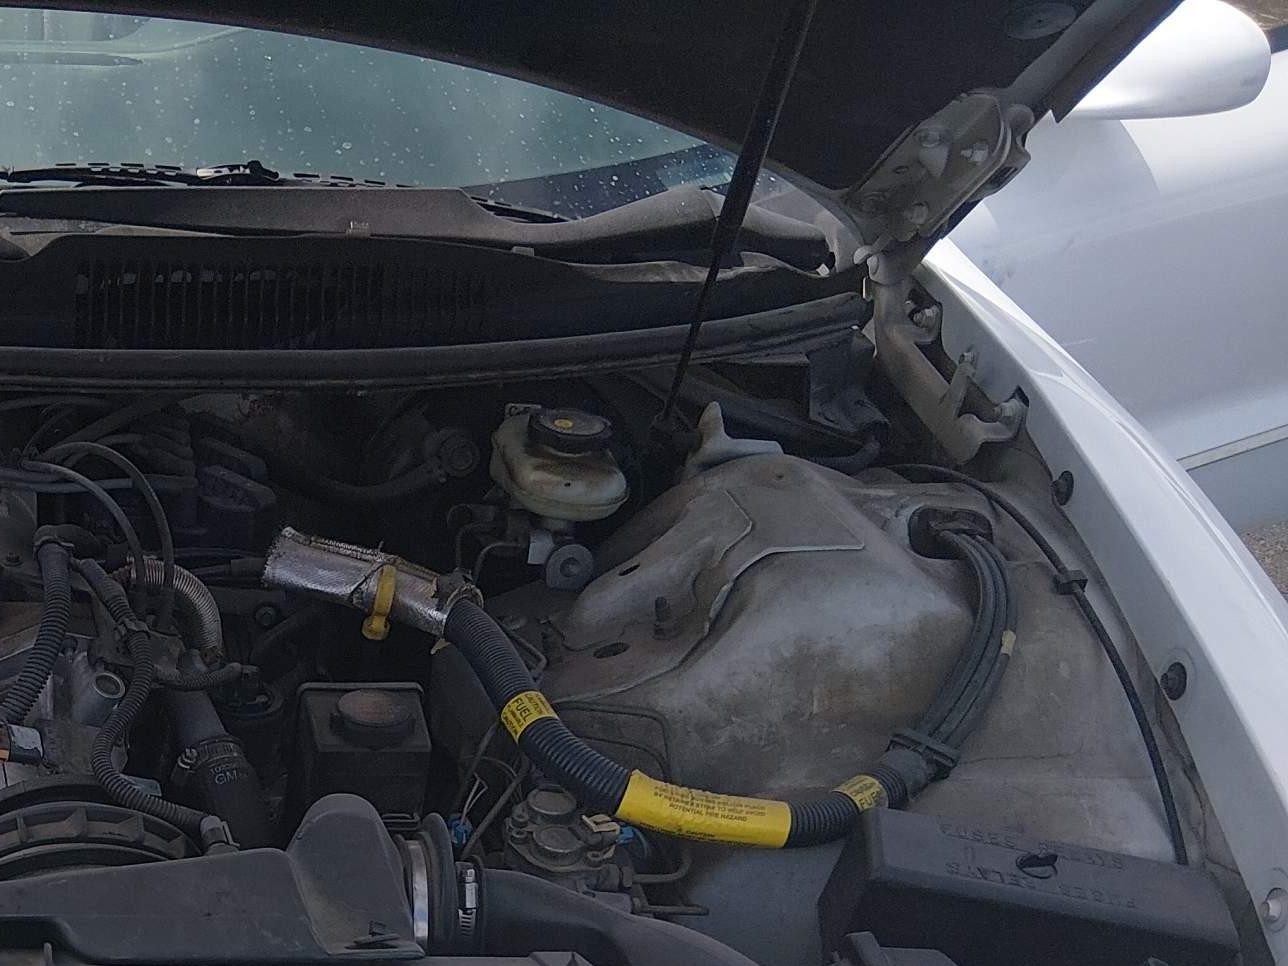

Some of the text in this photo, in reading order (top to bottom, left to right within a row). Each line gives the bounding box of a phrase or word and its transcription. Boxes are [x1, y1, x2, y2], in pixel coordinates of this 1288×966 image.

[512, 697, 533, 722] FUEL
[669, 803, 704, 817] POTENTIAL
[720, 813, 747, 822] HAZARD
